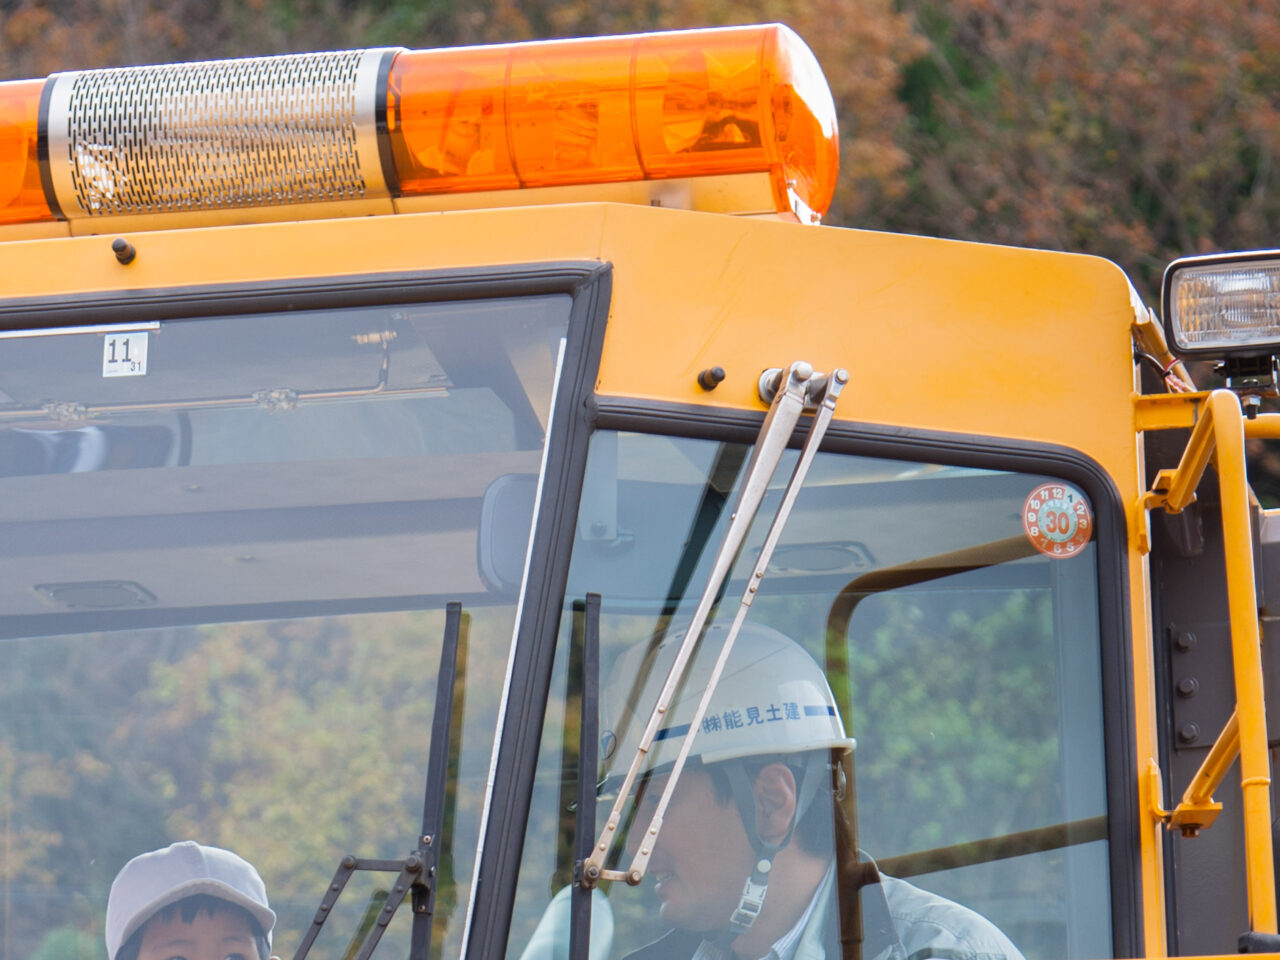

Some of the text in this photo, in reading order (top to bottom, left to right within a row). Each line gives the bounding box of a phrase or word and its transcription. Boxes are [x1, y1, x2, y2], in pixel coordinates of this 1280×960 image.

[108, 338, 131, 363] 11
[130, 361, 141, 372] 31
[1040, 490, 1049, 499] 11
[1052, 488, 1063, 498] 12
[1067, 494, 1073, 503] 1
[1030, 500, 1040, 509] 10
[1077, 505, 1085, 515] 2
[1028, 512, 1036, 522] 9
[1046, 511, 1069, 535] 30
[1031, 527, 1039, 536] 8
